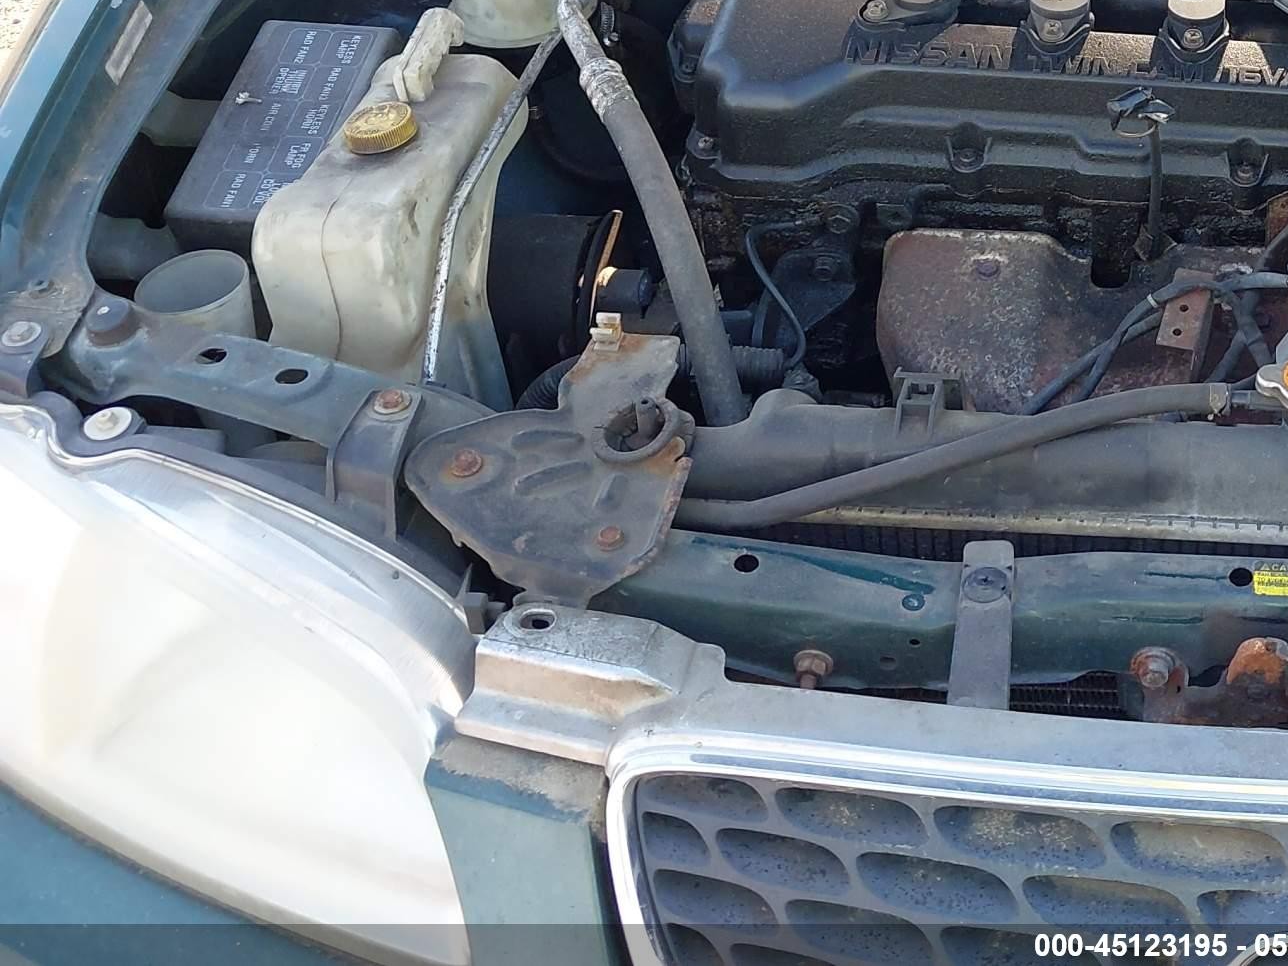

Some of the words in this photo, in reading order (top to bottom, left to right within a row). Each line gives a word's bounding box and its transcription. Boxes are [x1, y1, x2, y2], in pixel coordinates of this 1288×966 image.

[303, 30, 317, 45] RAD
[294, 46, 310, 64] FAN2
[335, 40, 350, 59] LAMP
[341, 35, 362, 64] KEYLESS
[845, 36, 1013, 70] NISSAN
[268, 67, 285, 94] OPENER
[328, 67, 342, 83] RAD
[270, 102, 282, 117] AIR
[307, 104, 329, 135] KEYLESS
[284, 145, 300, 166] LAMP
[233, 173, 246, 189] RAD
